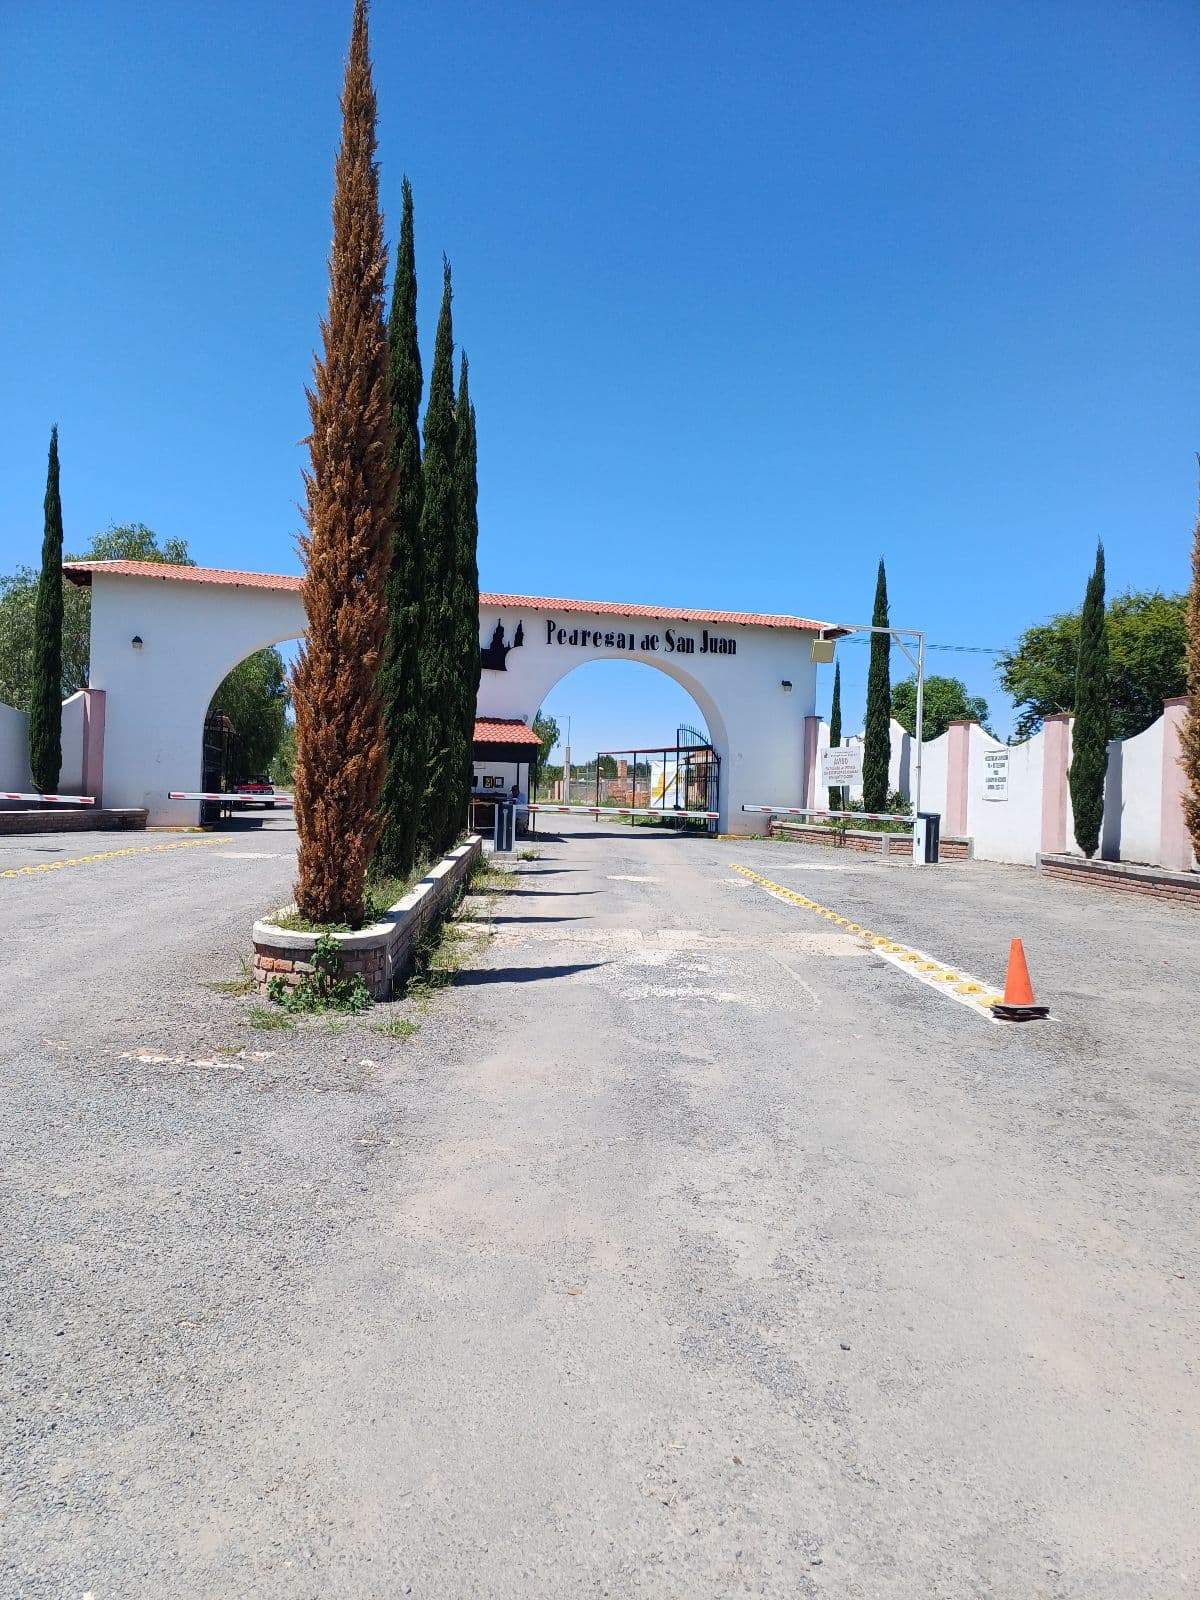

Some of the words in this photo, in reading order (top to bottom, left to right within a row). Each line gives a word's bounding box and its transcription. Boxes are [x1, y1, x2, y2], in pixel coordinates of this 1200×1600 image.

[546, 619, 635, 650] Pedregal
[640, 633, 659, 651] de
[664, 628, 695, 653] San
[699, 630, 737, 654] Juan
